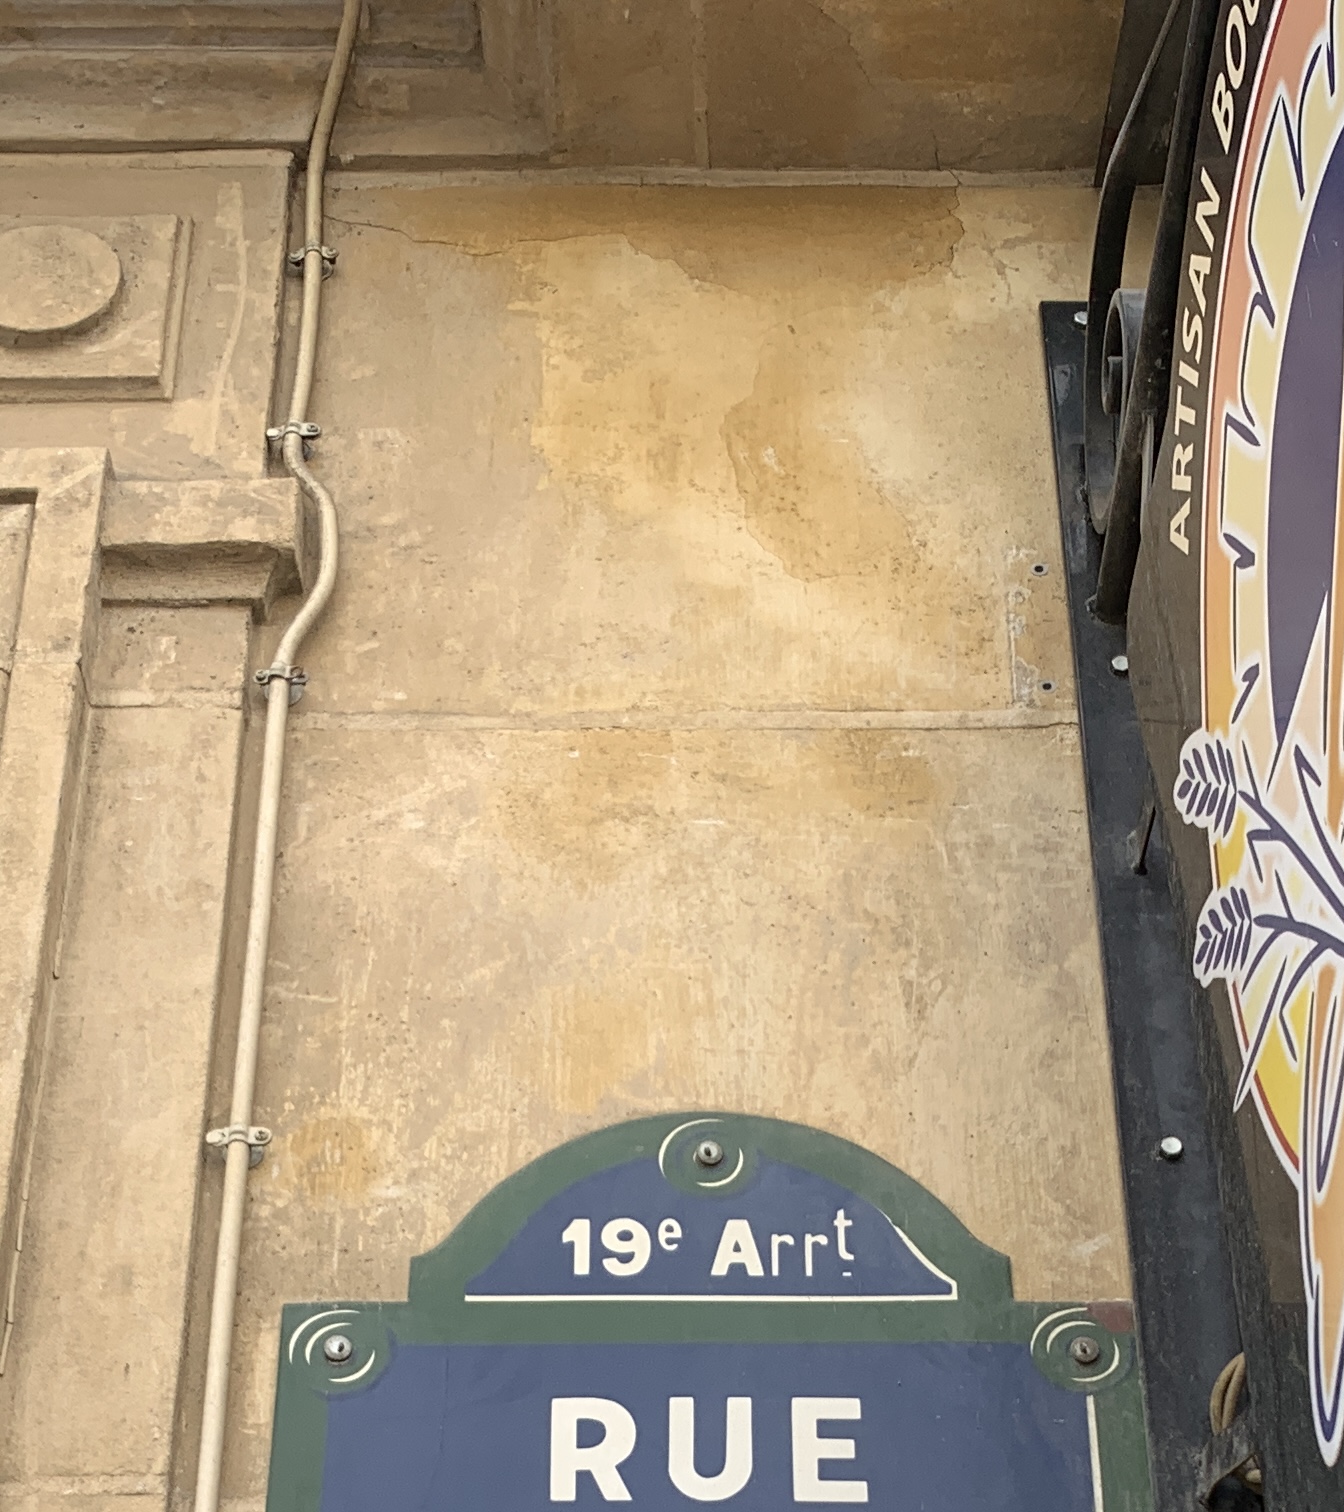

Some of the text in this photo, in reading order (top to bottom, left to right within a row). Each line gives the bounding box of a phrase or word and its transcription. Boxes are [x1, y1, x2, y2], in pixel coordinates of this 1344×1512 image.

[1170, 167, 1224, 556] ARTISAN
[561, 1216, 682, 1277] 19e
[549, 1396, 869, 1503] RUE
